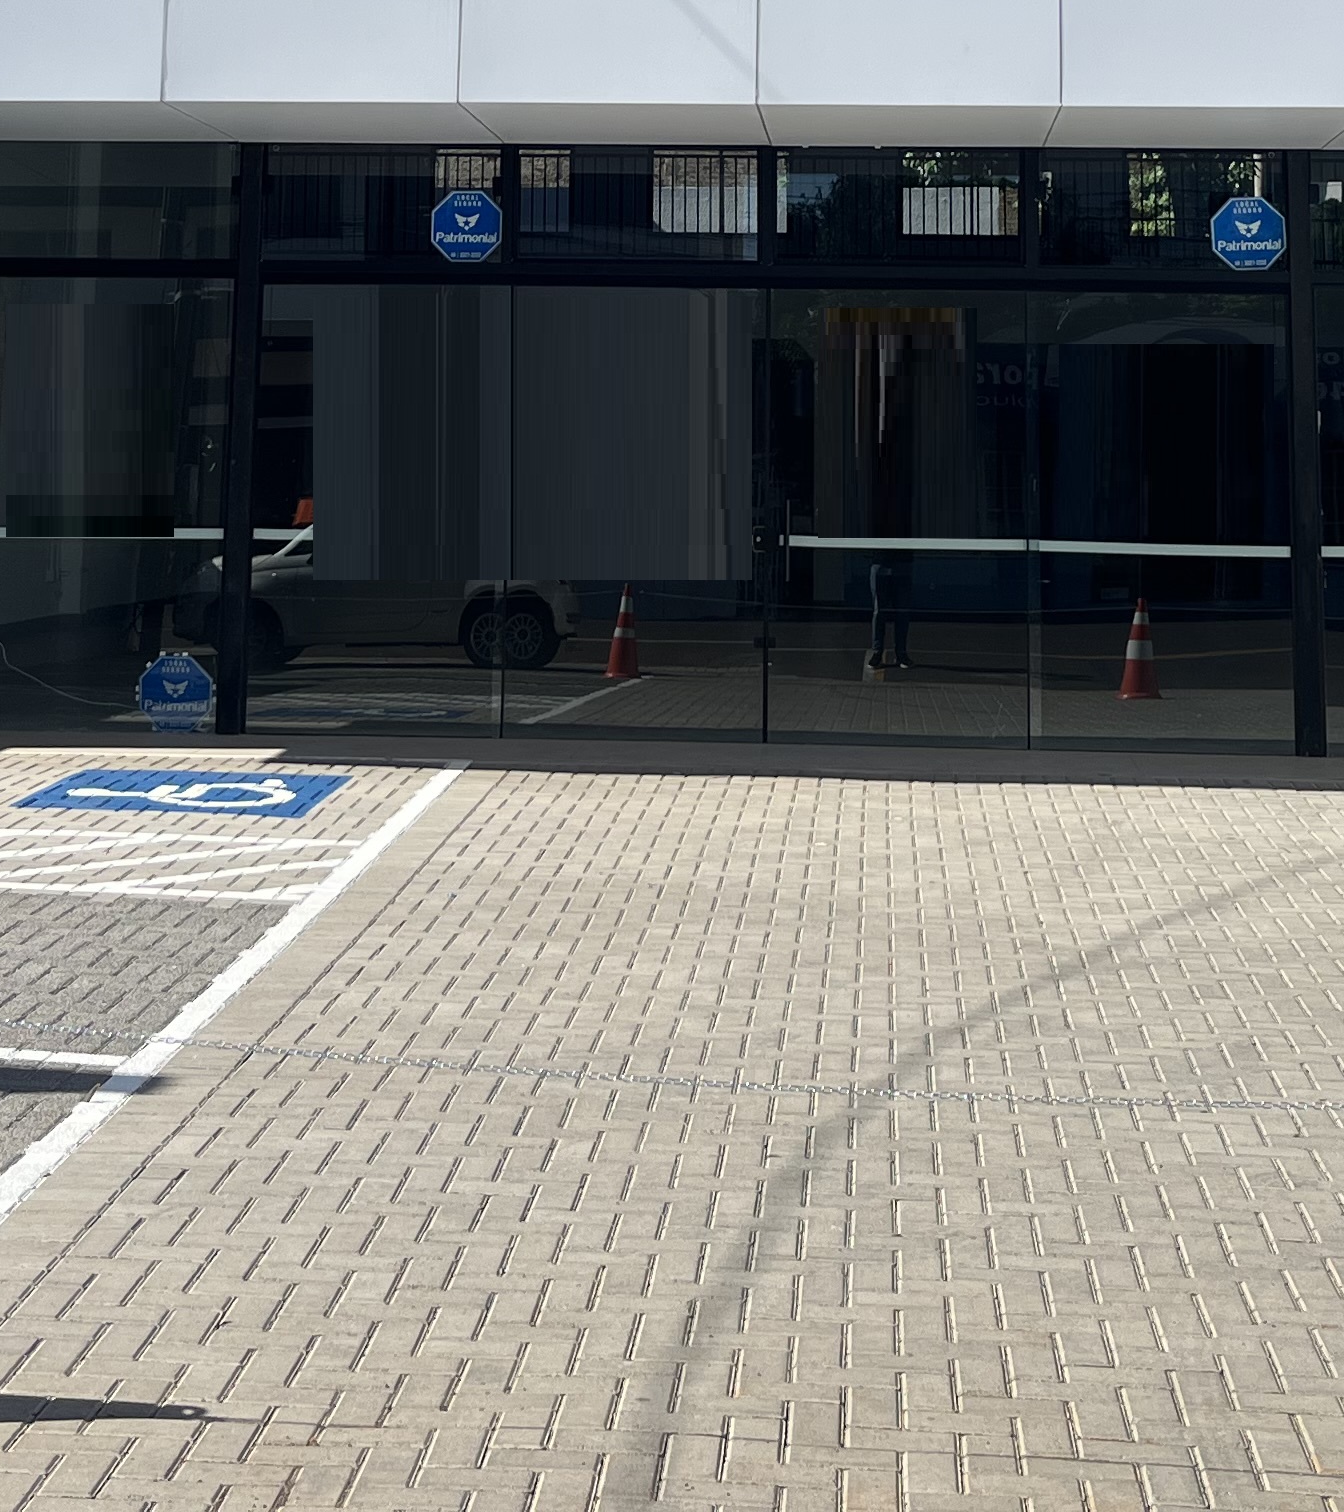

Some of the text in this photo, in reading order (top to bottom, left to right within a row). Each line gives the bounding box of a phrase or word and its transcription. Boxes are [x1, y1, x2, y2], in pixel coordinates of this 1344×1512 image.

[436, 231, 497, 243] Patrimonial
[1217, 239, 1282, 251] Patrimonial
[144, 699, 207, 712] Patrimonial
